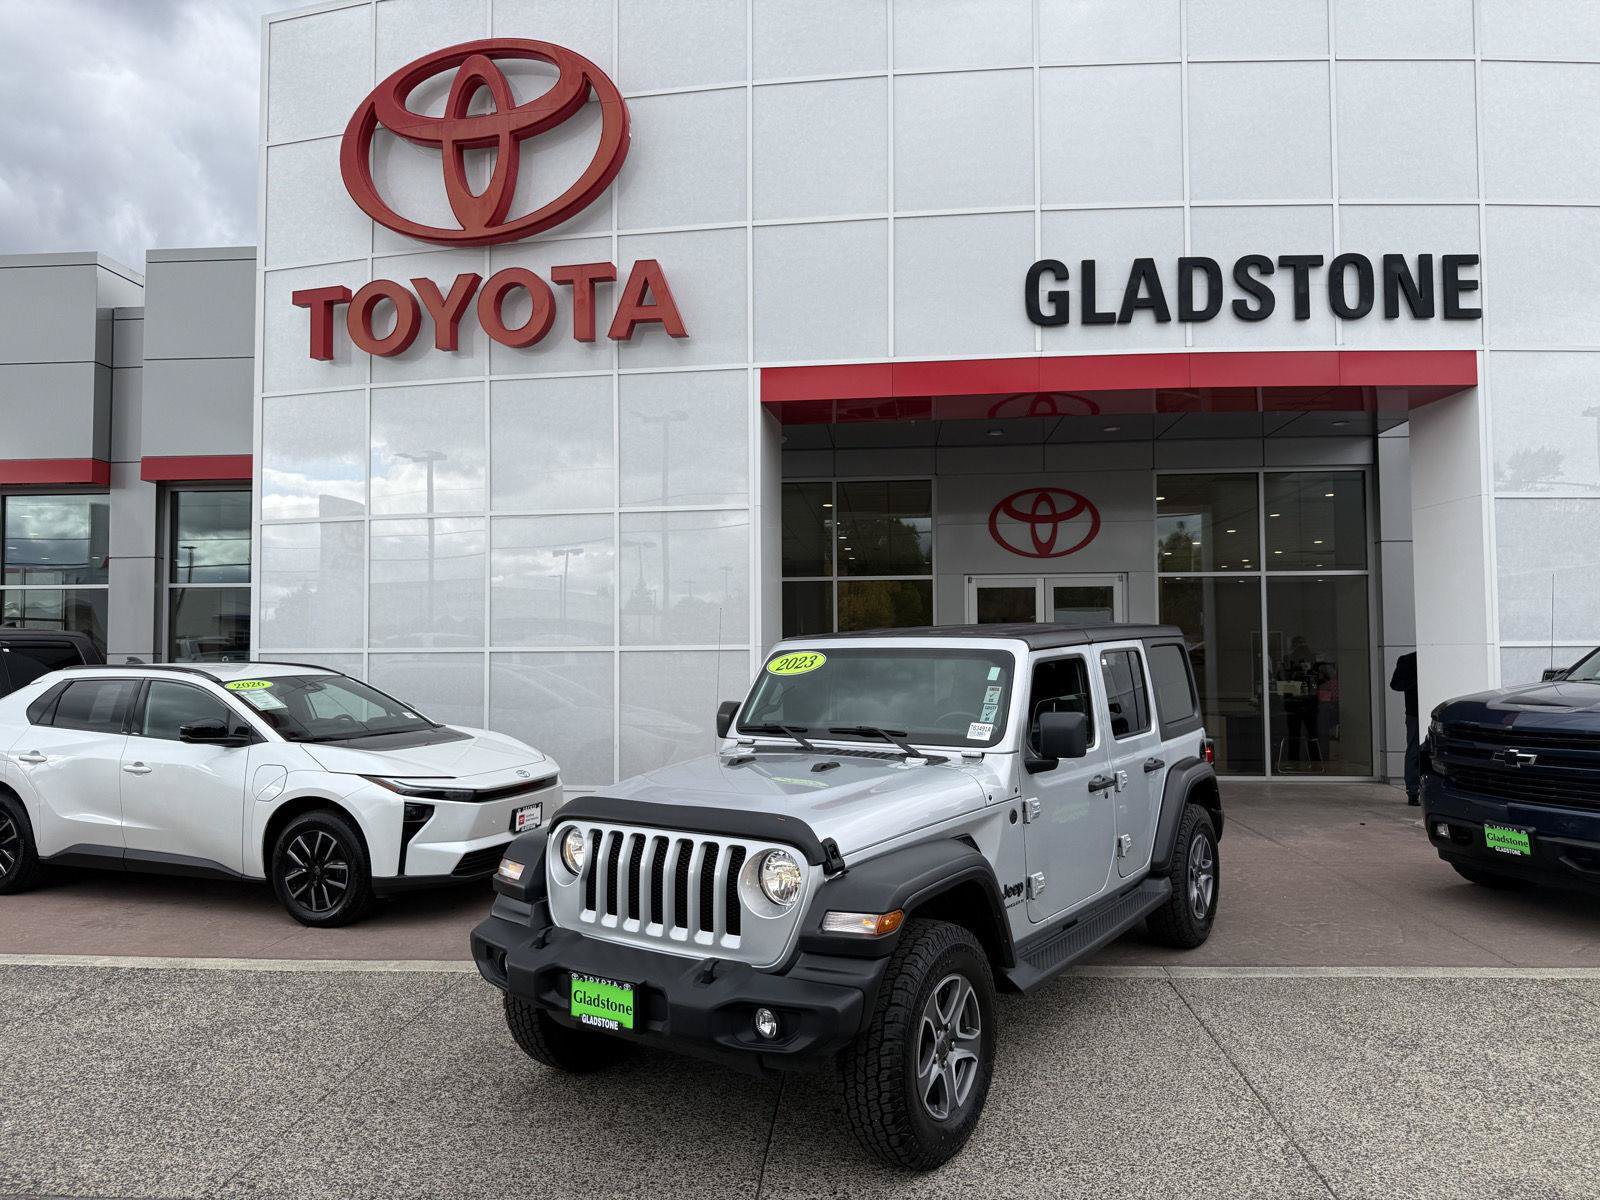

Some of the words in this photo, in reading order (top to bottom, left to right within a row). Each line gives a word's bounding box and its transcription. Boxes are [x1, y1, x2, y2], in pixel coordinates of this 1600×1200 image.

[1025, 253, 1482, 327] GLADSTONE
[292, 259, 690, 361] TOYOTA
[775, 655, 818, 671] 2023
[233, 681, 266, 689] 2026
[1487, 832, 1529, 848] Gladstone
[1002, 881, 1024, 899] Jeep
[583, 975, 619, 988] TOYOTA
[573, 989, 633, 1016] Gladstone
[581, 1013, 619, 1031] GLADSTONE
